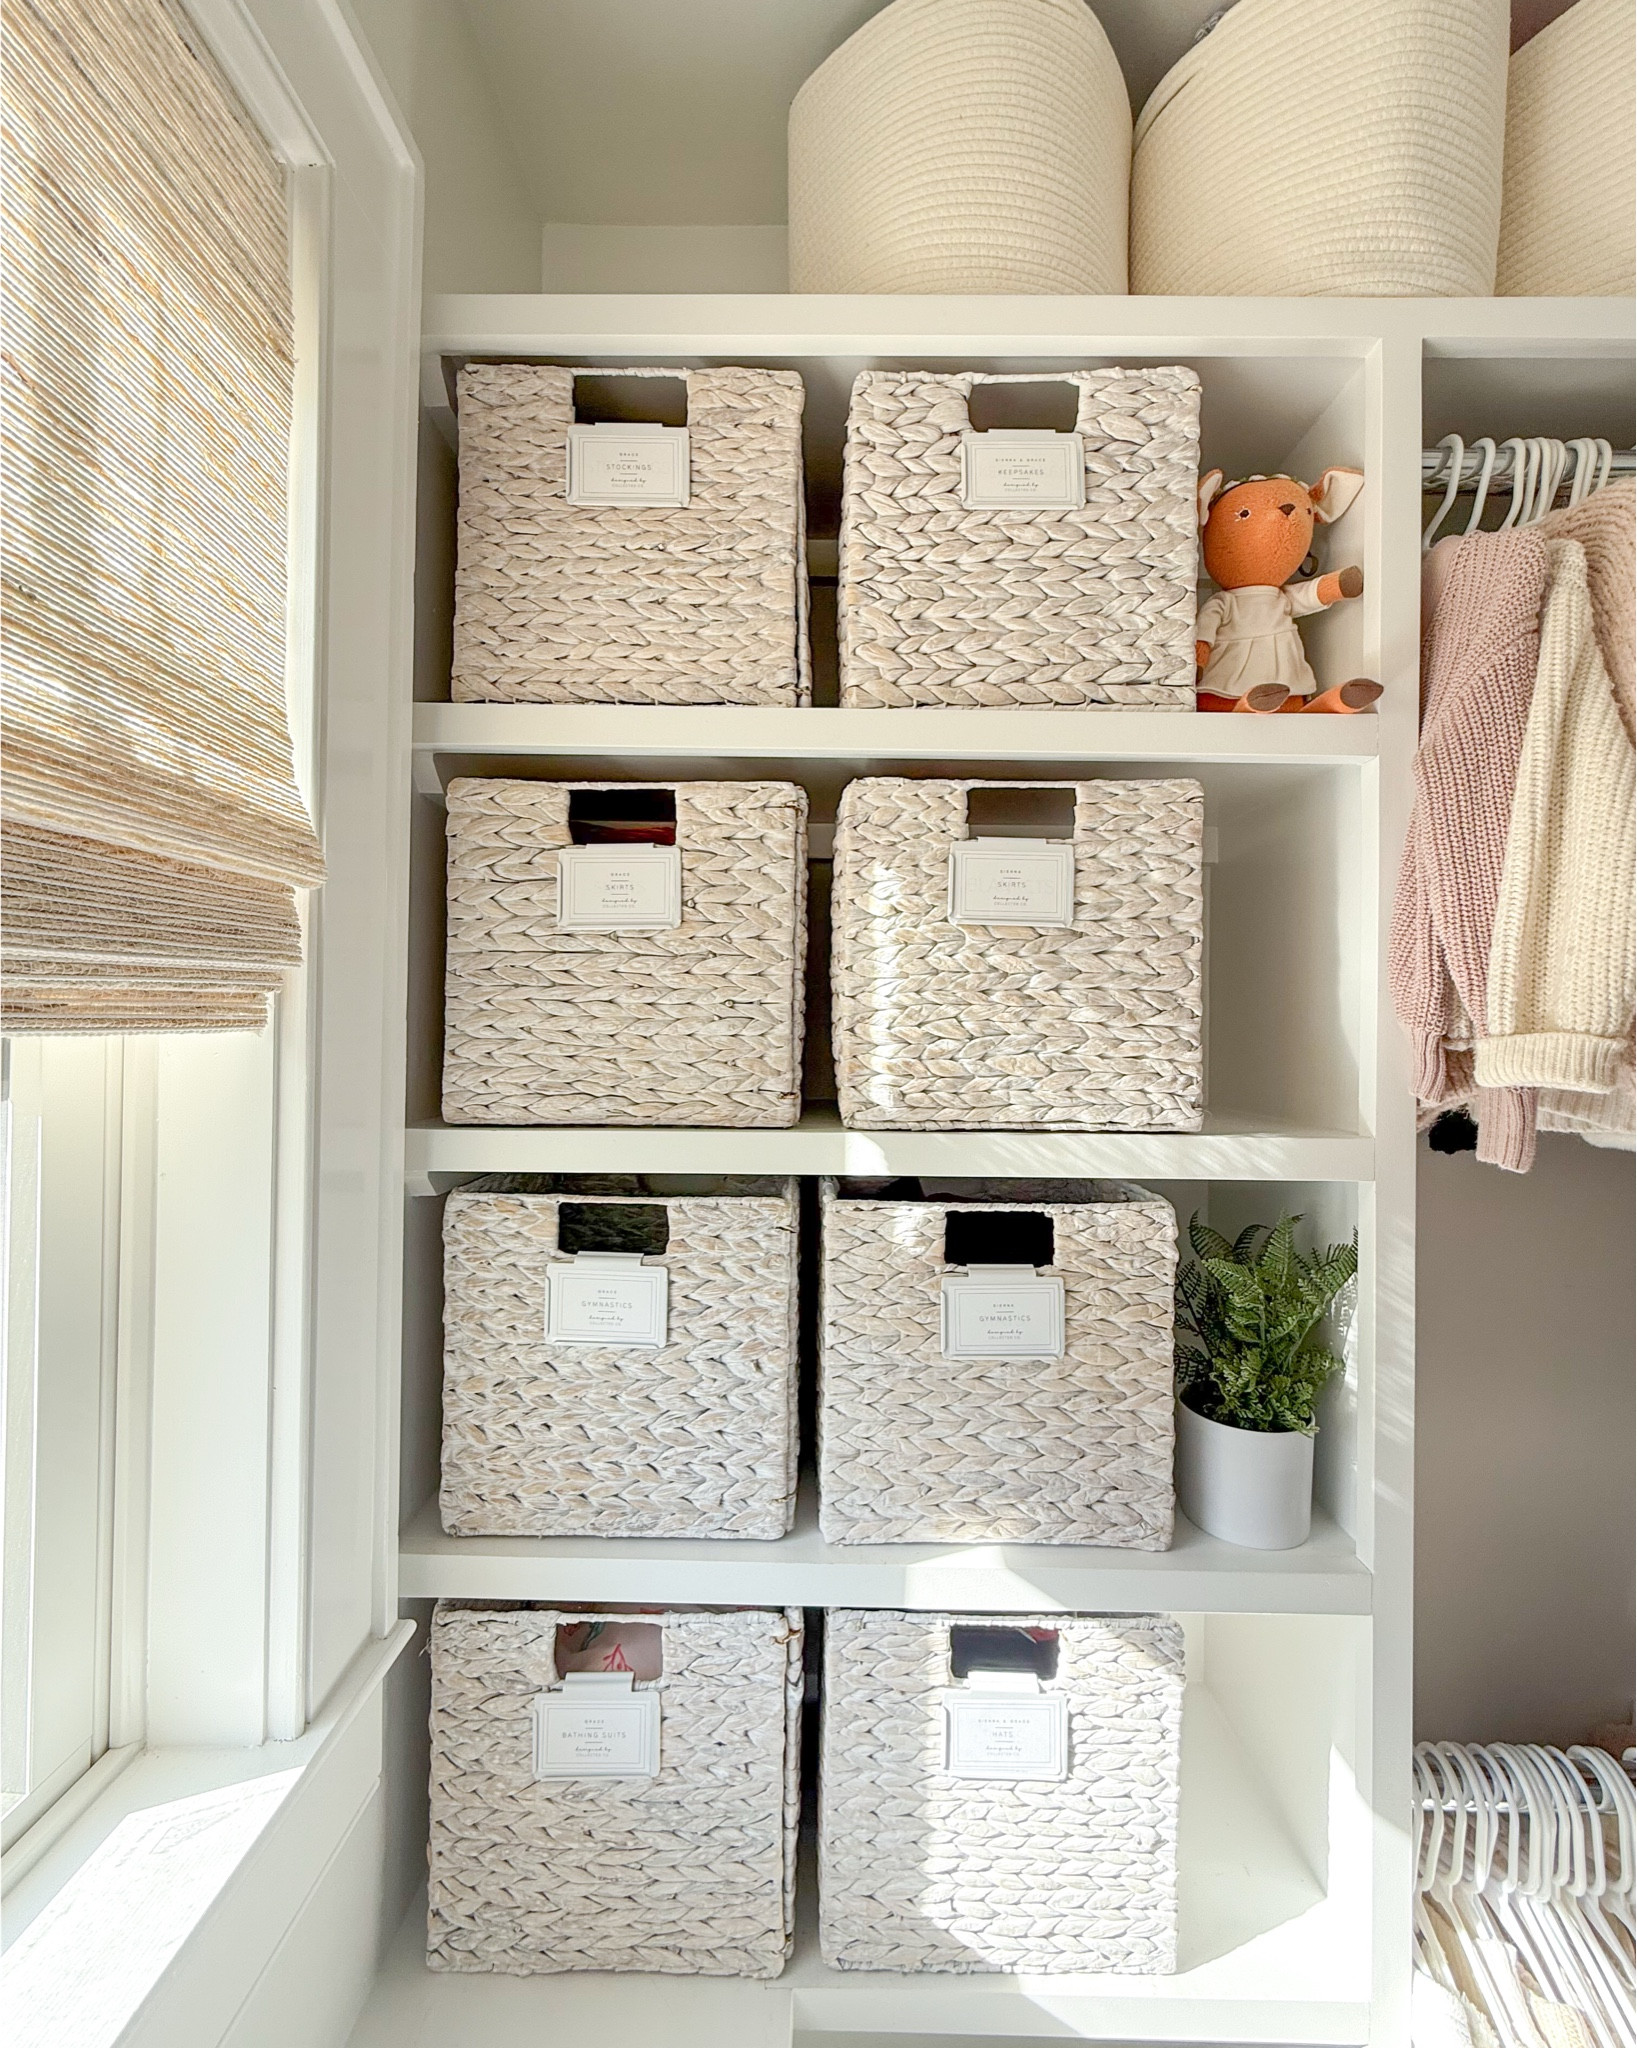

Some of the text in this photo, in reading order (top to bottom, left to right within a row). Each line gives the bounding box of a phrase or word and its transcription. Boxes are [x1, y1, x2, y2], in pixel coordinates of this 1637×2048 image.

[606, 463, 652, 471] STOCKINGS
[581, 1300, 633, 1309] GYMNASTICS
[602, 1731, 627, 1739] SUITS
